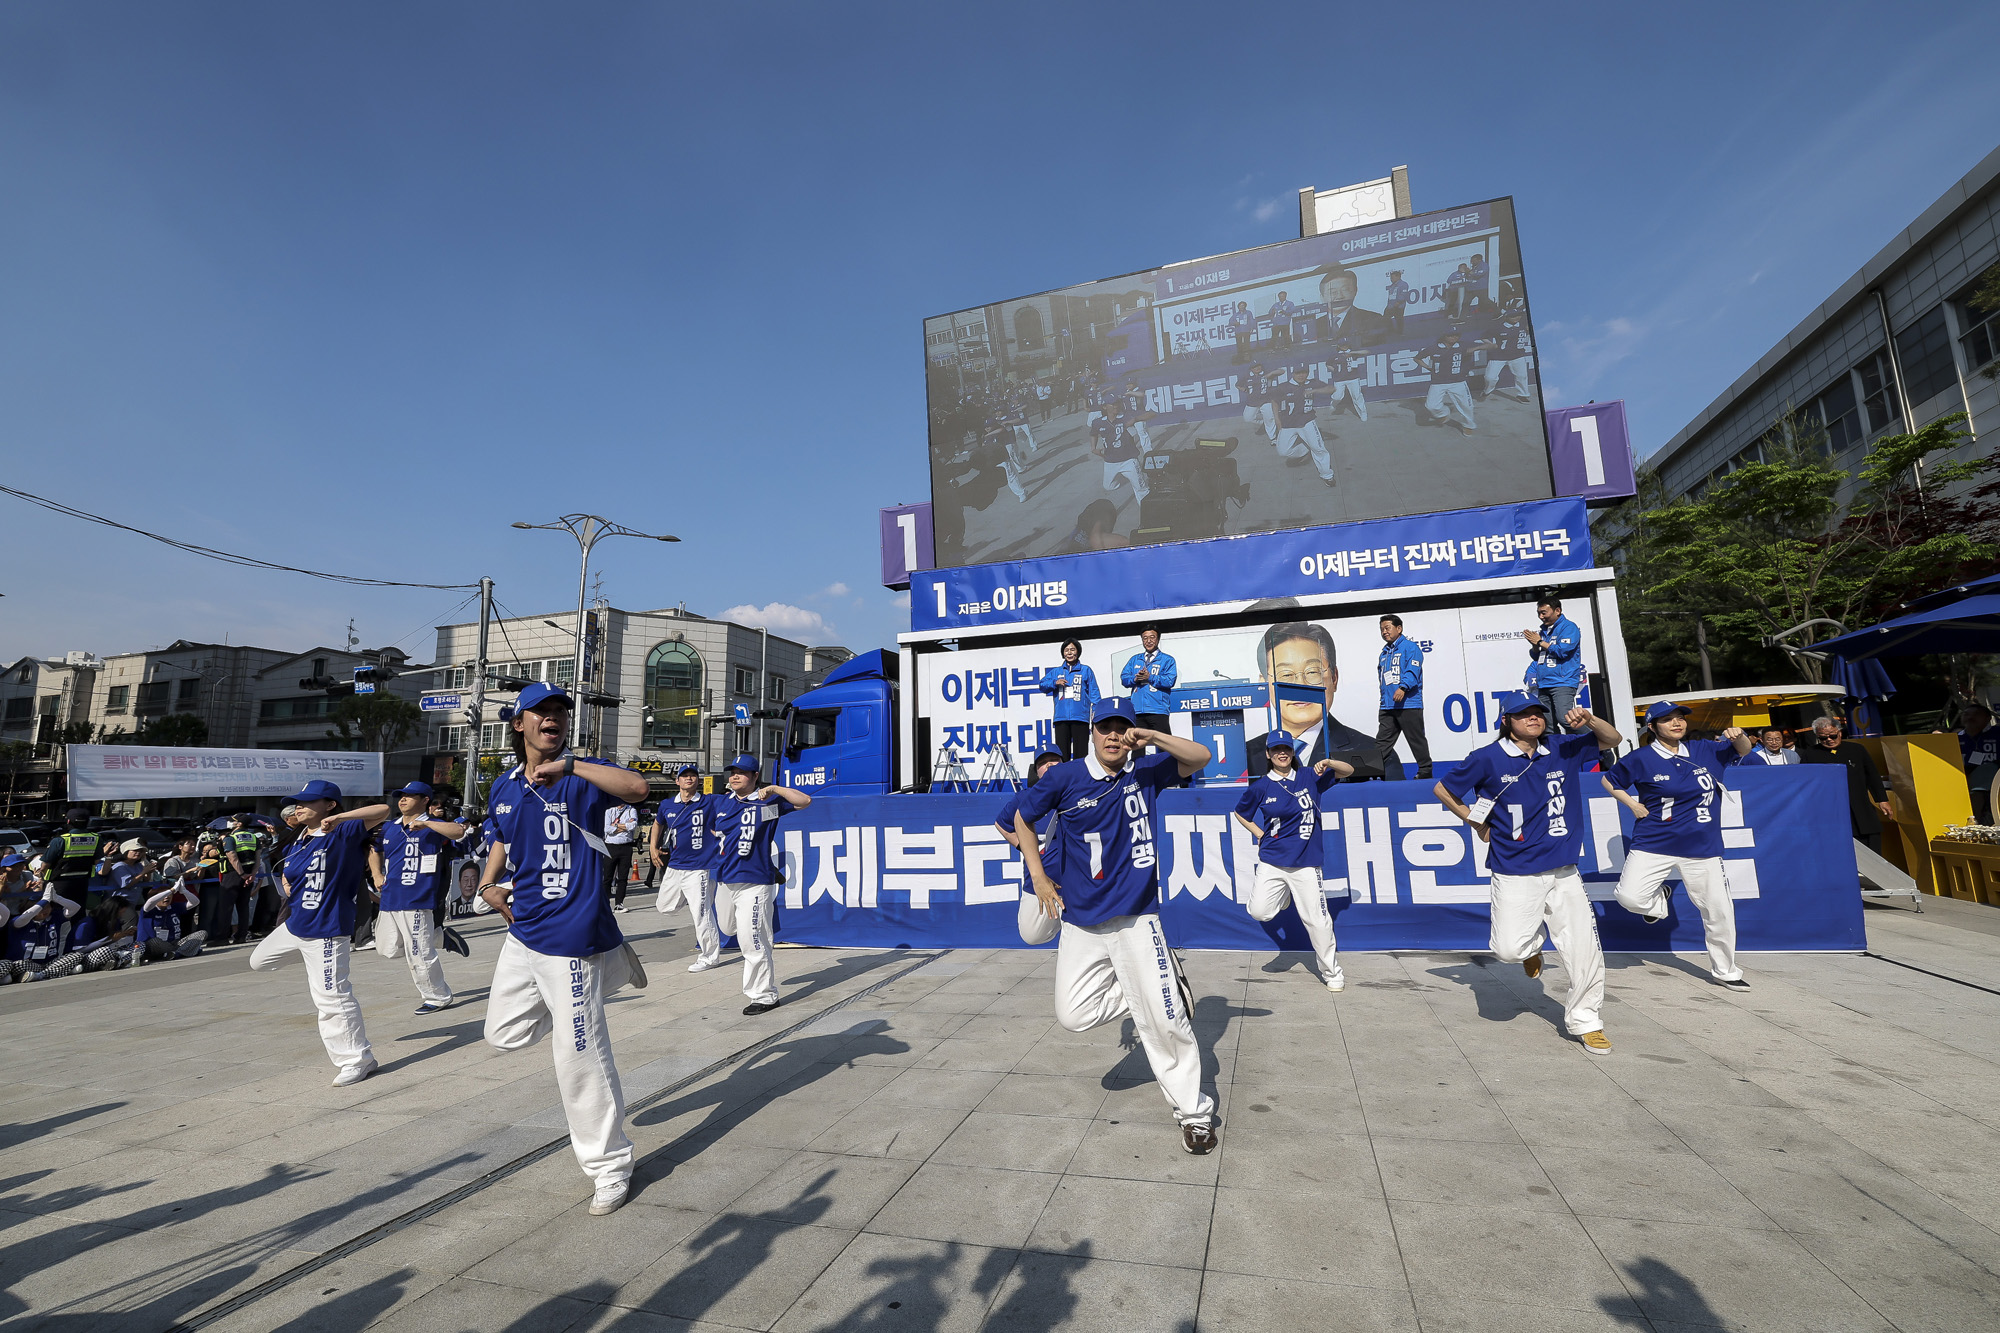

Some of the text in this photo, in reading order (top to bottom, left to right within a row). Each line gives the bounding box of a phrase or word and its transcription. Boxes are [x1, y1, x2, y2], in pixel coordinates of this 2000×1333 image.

[1342, 212, 1480, 252] 이제부터 진짜 대한민국
[1166, 278, 1174, 293] 1
[1194, 268, 1231, 287] 이재명
[1174, 301, 1238, 327] 이제부터
[1144, 375, 1240, 414] 제부터
[1570, 415, 1606, 486] 1
[897, 513, 918, 572] 1
[1300, 528, 1571, 580] 이제부터 진짜 대한민국
[933, 580, 1068, 618] 1 지금은 이재명
[1475, 632, 1512, 641] 더불어민주당
[542, 681, 552, 691] 1
[1391, 656, 1401, 685] 이재명
[1112, 699, 1119, 709] 1
[1180, 690, 1253, 710] 지금은 1 이재명
[1520, 691, 1530, 699] 1
[1213, 718, 1237, 727] 대한민국
[1213, 734, 1226, 763] 1
[662, 762, 697, 775] 밥버
[784, 769, 826, 787] 1 이재명
[1546, 770, 1564, 780] 지금은
[1123, 781, 1141, 795] 지금은
[1695, 774, 1714, 823] 이재명
[543, 802, 568, 812] 지금은
[1297, 793, 1314, 840] 이재명
[1507, 804, 1524, 842] 1
[1547, 777, 1568, 837] 이재명
[691, 814, 704, 850] 이재명
[738, 810, 757, 856] 이재명
[1124, 790, 1156, 869] 이재명
[400, 843, 420, 886] 이재명
[541, 814, 571, 900] 이재명
[1084, 832, 1104, 879] 1
[1157, 811, 1258, 905] 짜
[301, 852, 326, 910] 이재명
[451, 901, 457, 916] 1
[1148, 921, 1168, 970] 1 이재명
[570, 958, 584, 998] 이재명
[1162, 987, 1175, 1020] 민주당
[573, 1015, 587, 1052] 민주당
